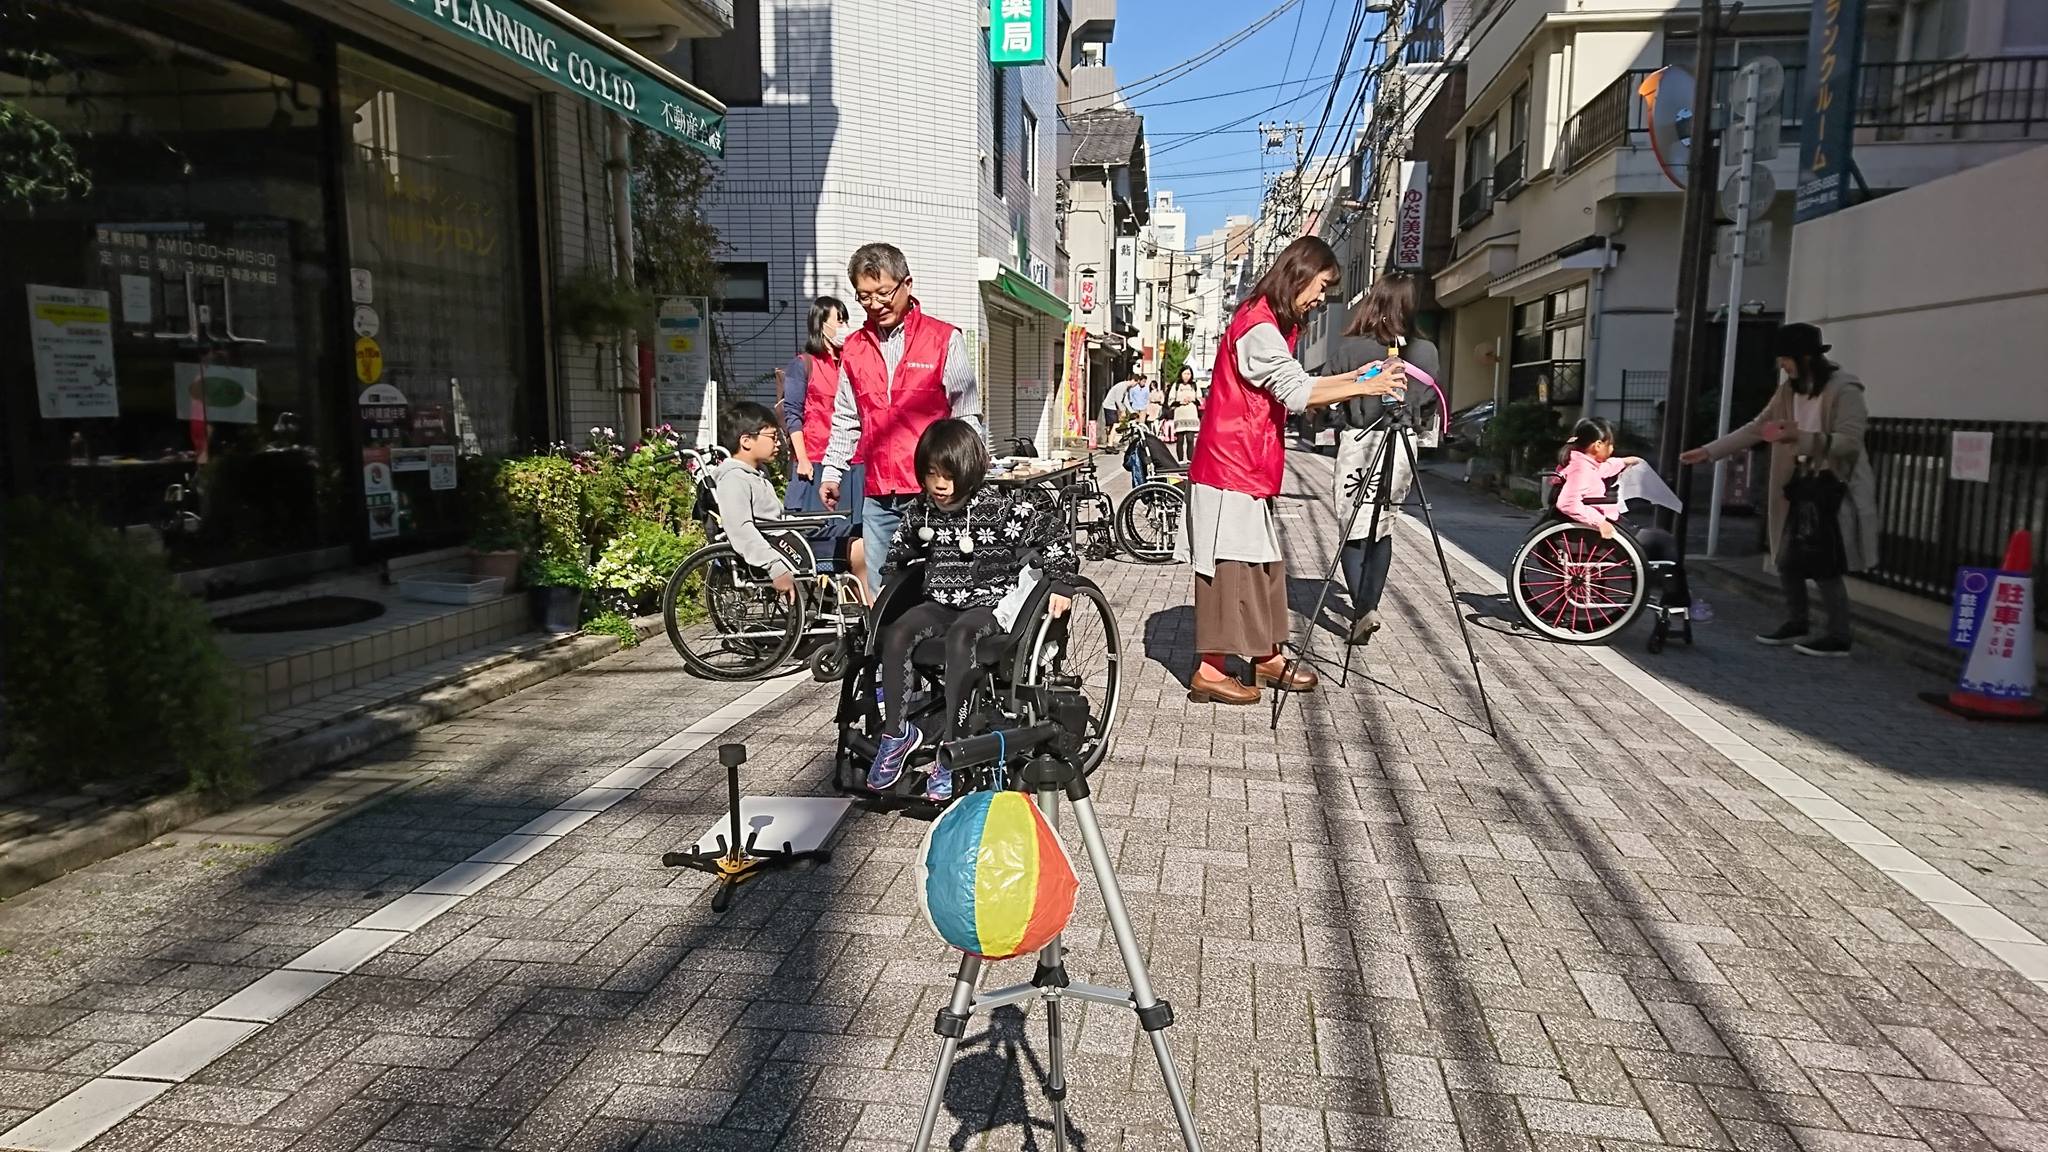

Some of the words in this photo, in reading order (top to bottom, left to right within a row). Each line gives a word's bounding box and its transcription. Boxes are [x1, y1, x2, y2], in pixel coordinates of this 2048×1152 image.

[434, 0, 560, 73] PLANNING
[568, 51, 641, 115] CO.LTD.
[1400, 189, 1422, 264] ゆだ美容室
[1082, 281, 1094, 308] 防火
[778, 539, 804, 566] ULTRA
[1993, 583, 2025, 626] 駐車
